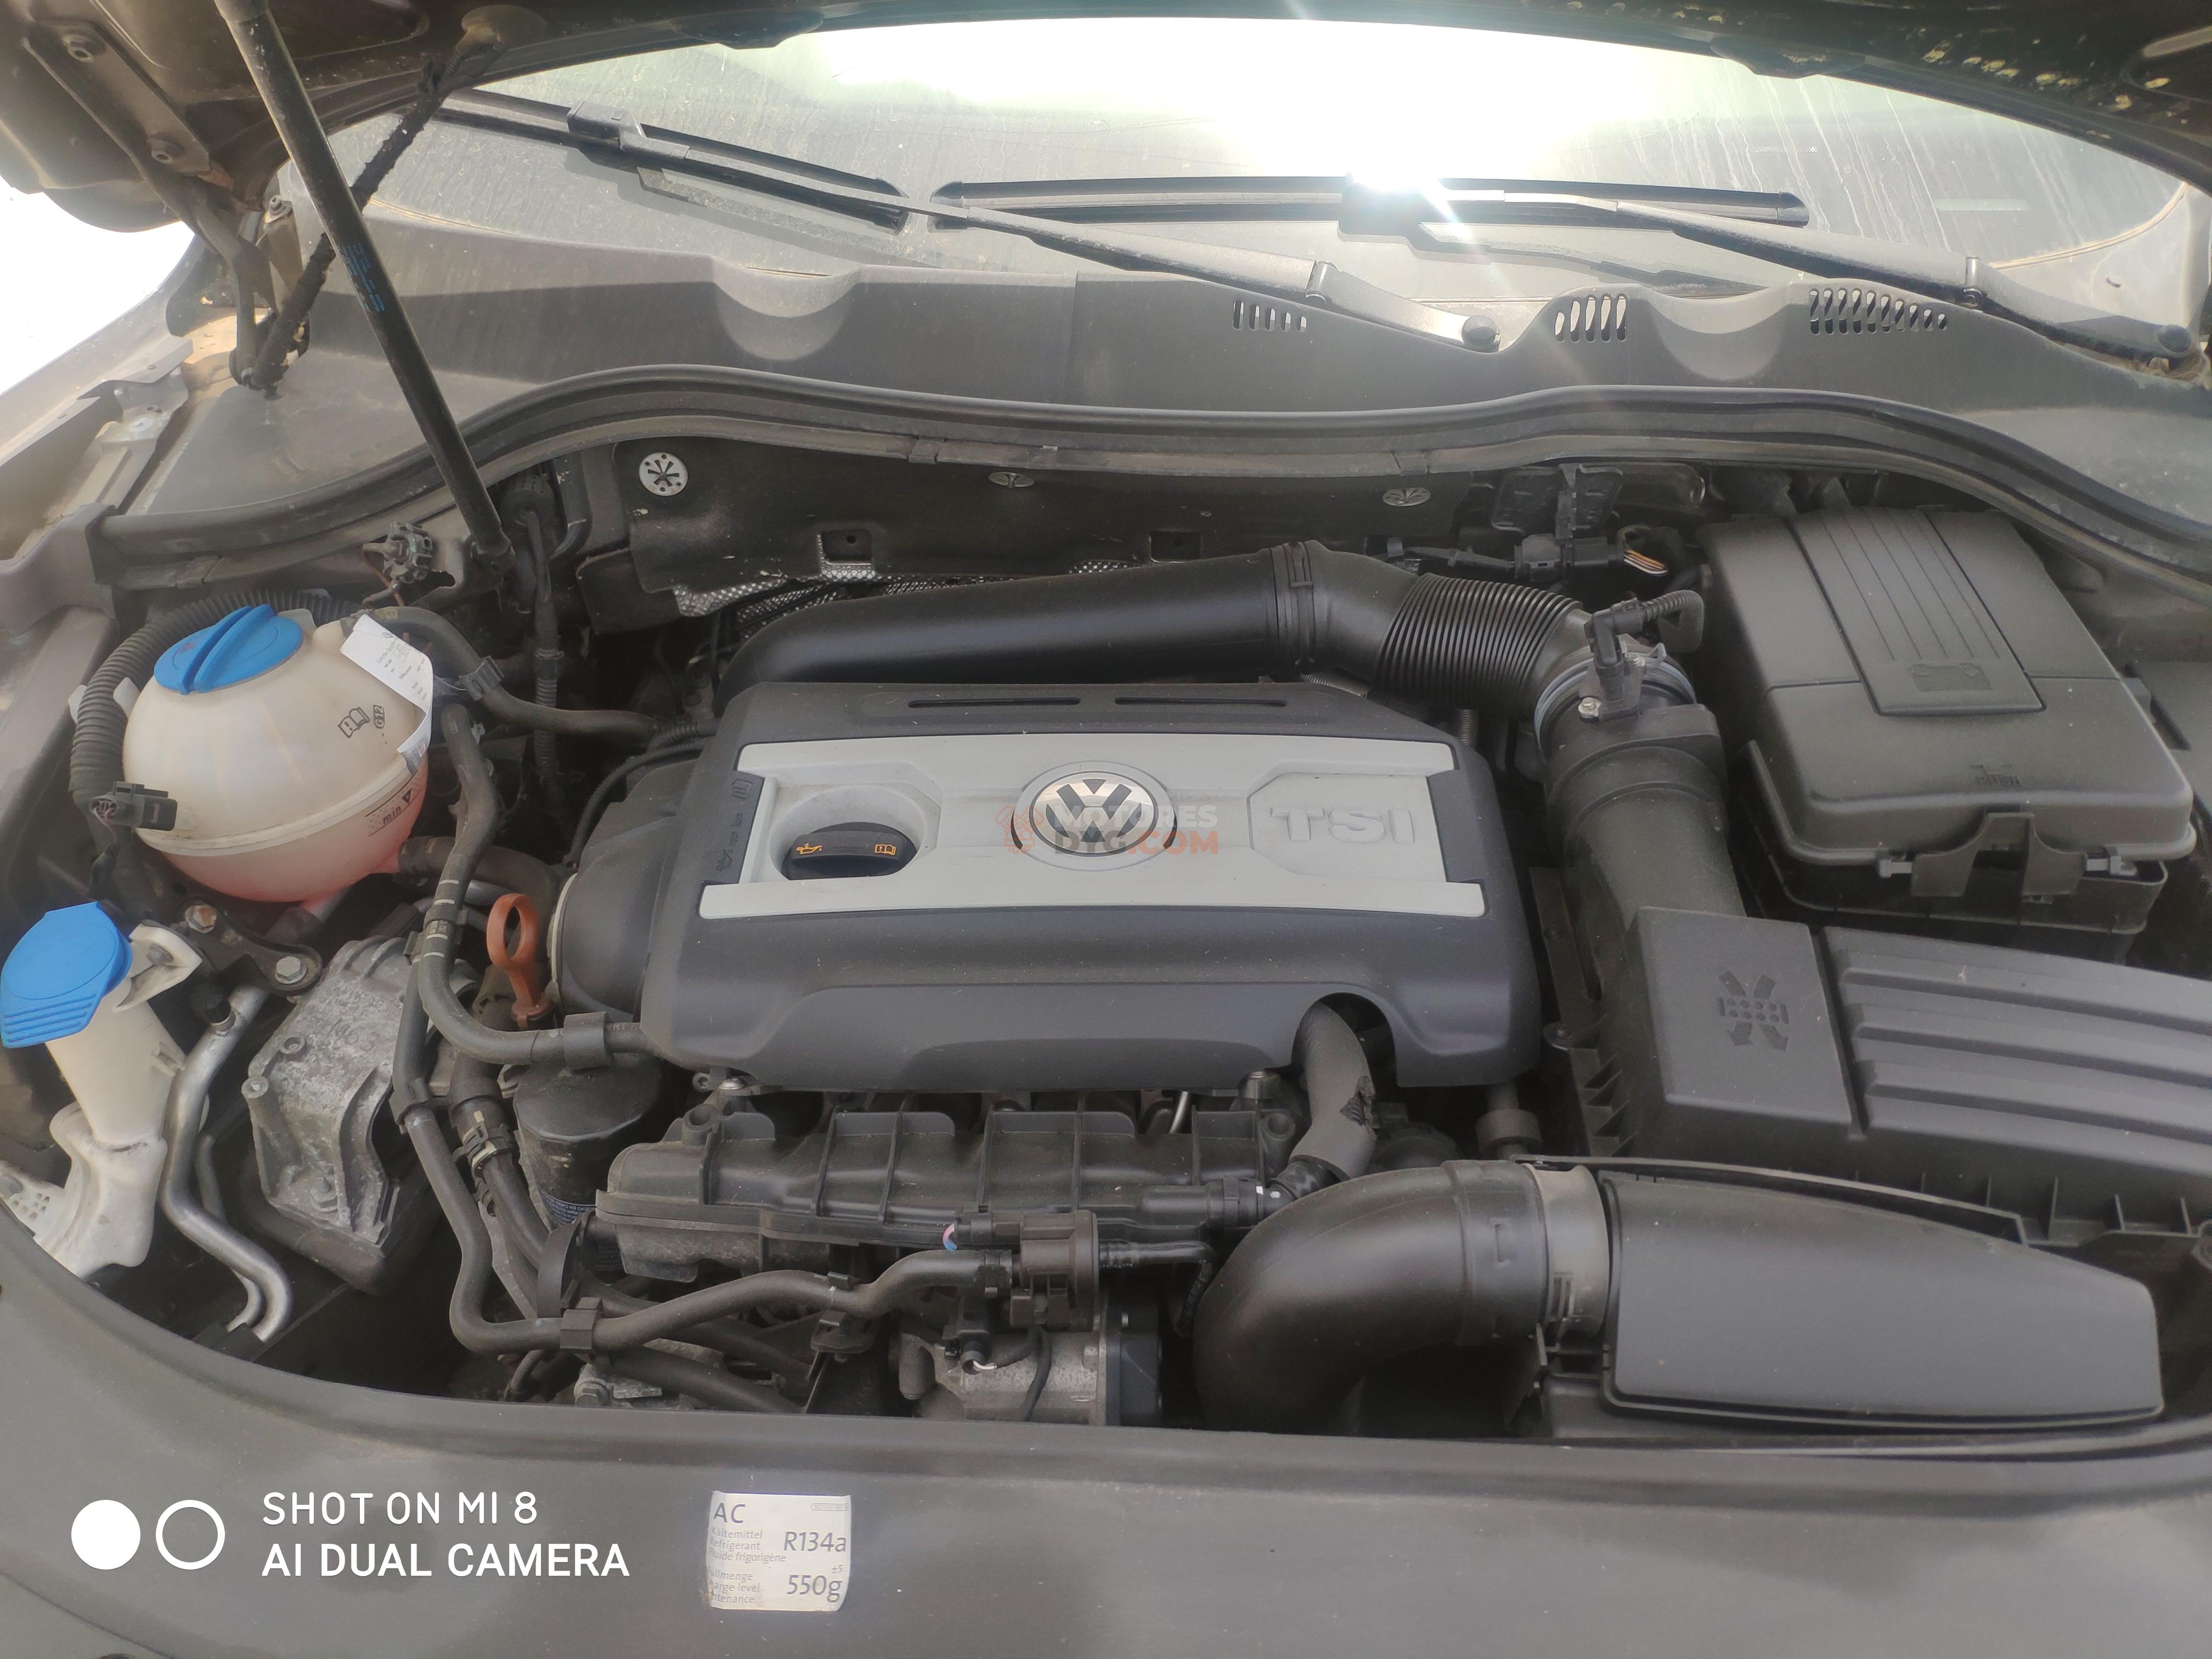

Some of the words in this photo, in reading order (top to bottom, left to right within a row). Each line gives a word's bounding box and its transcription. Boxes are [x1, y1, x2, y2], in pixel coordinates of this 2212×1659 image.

[374, 706, 384, 727] G12
[383, 806, 402, 825] min
[1270, 808, 1415, 844] TSI
[713, 1502, 746, 1523] AC
[712, 1525, 763, 1539] Kältemittel
[710, 1536, 761, 1551] Refrigerant
[783, 1531, 847, 1553] R134a
[709, 1547, 733, 1561] Fluide
[736, 1551, 786, 1564] frigorigène
[712, 1590, 755, 1604] ntenance
[738, 1582, 760, 1593] level
[786, 1575, 843, 1604] 550g
